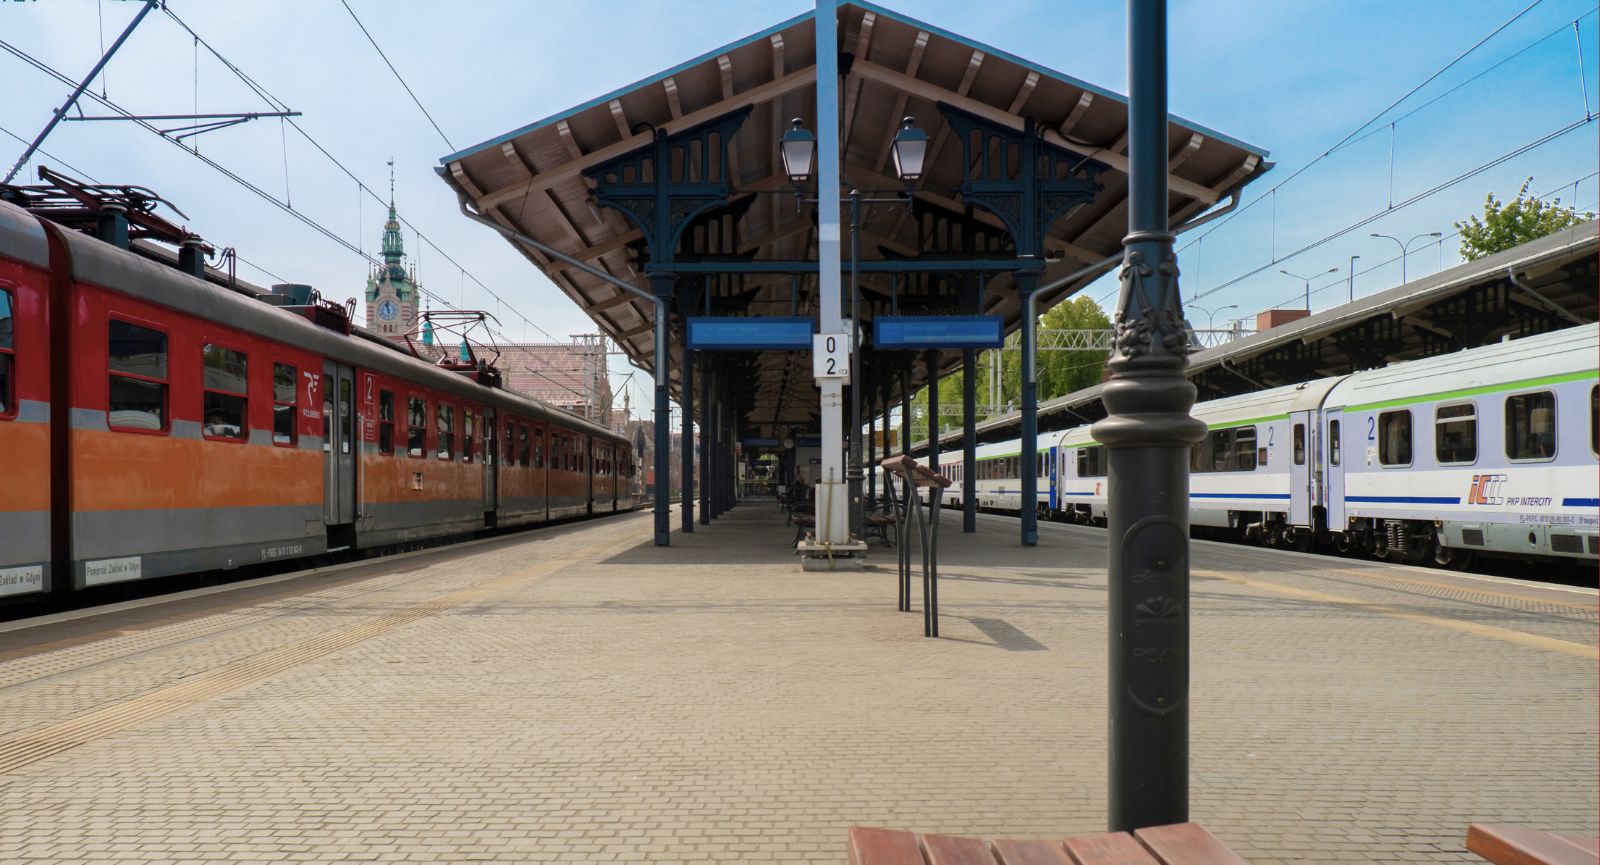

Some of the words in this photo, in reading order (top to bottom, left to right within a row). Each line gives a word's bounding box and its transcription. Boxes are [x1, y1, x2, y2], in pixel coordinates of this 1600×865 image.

[826, 336, 836, 353] 0
[826, 358, 836, 375] 2
[367, 377, 373, 400] 2
[1268, 426, 1274, 447] 2
[1367, 416, 1375, 440] 2
[1507, 497, 1519, 506] PKP
[1520, 497, 1552, 506] INTERCITY
